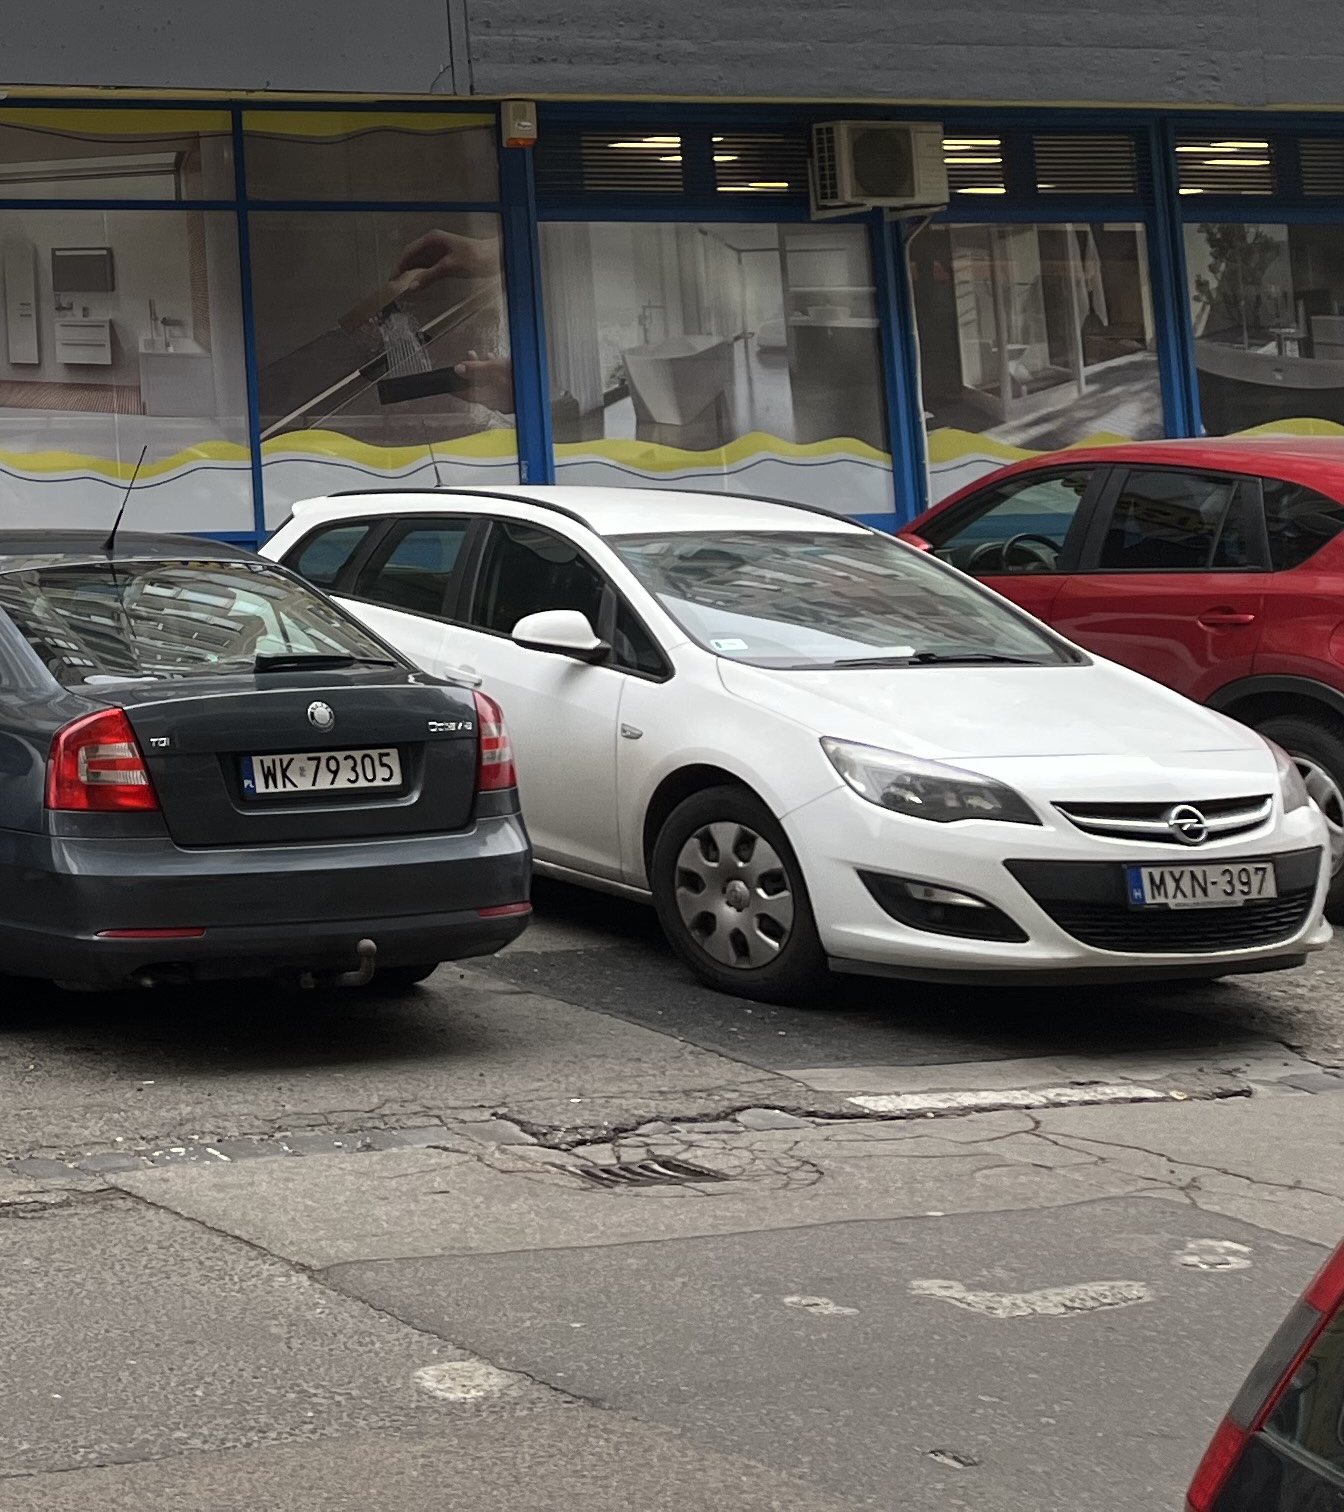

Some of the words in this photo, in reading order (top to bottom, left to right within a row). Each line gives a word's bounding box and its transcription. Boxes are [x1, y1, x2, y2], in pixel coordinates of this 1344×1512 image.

[259, 757, 299, 790] WK
[306, 752, 394, 787] 79305
[1148, 866, 1267, 900] MXN-397
